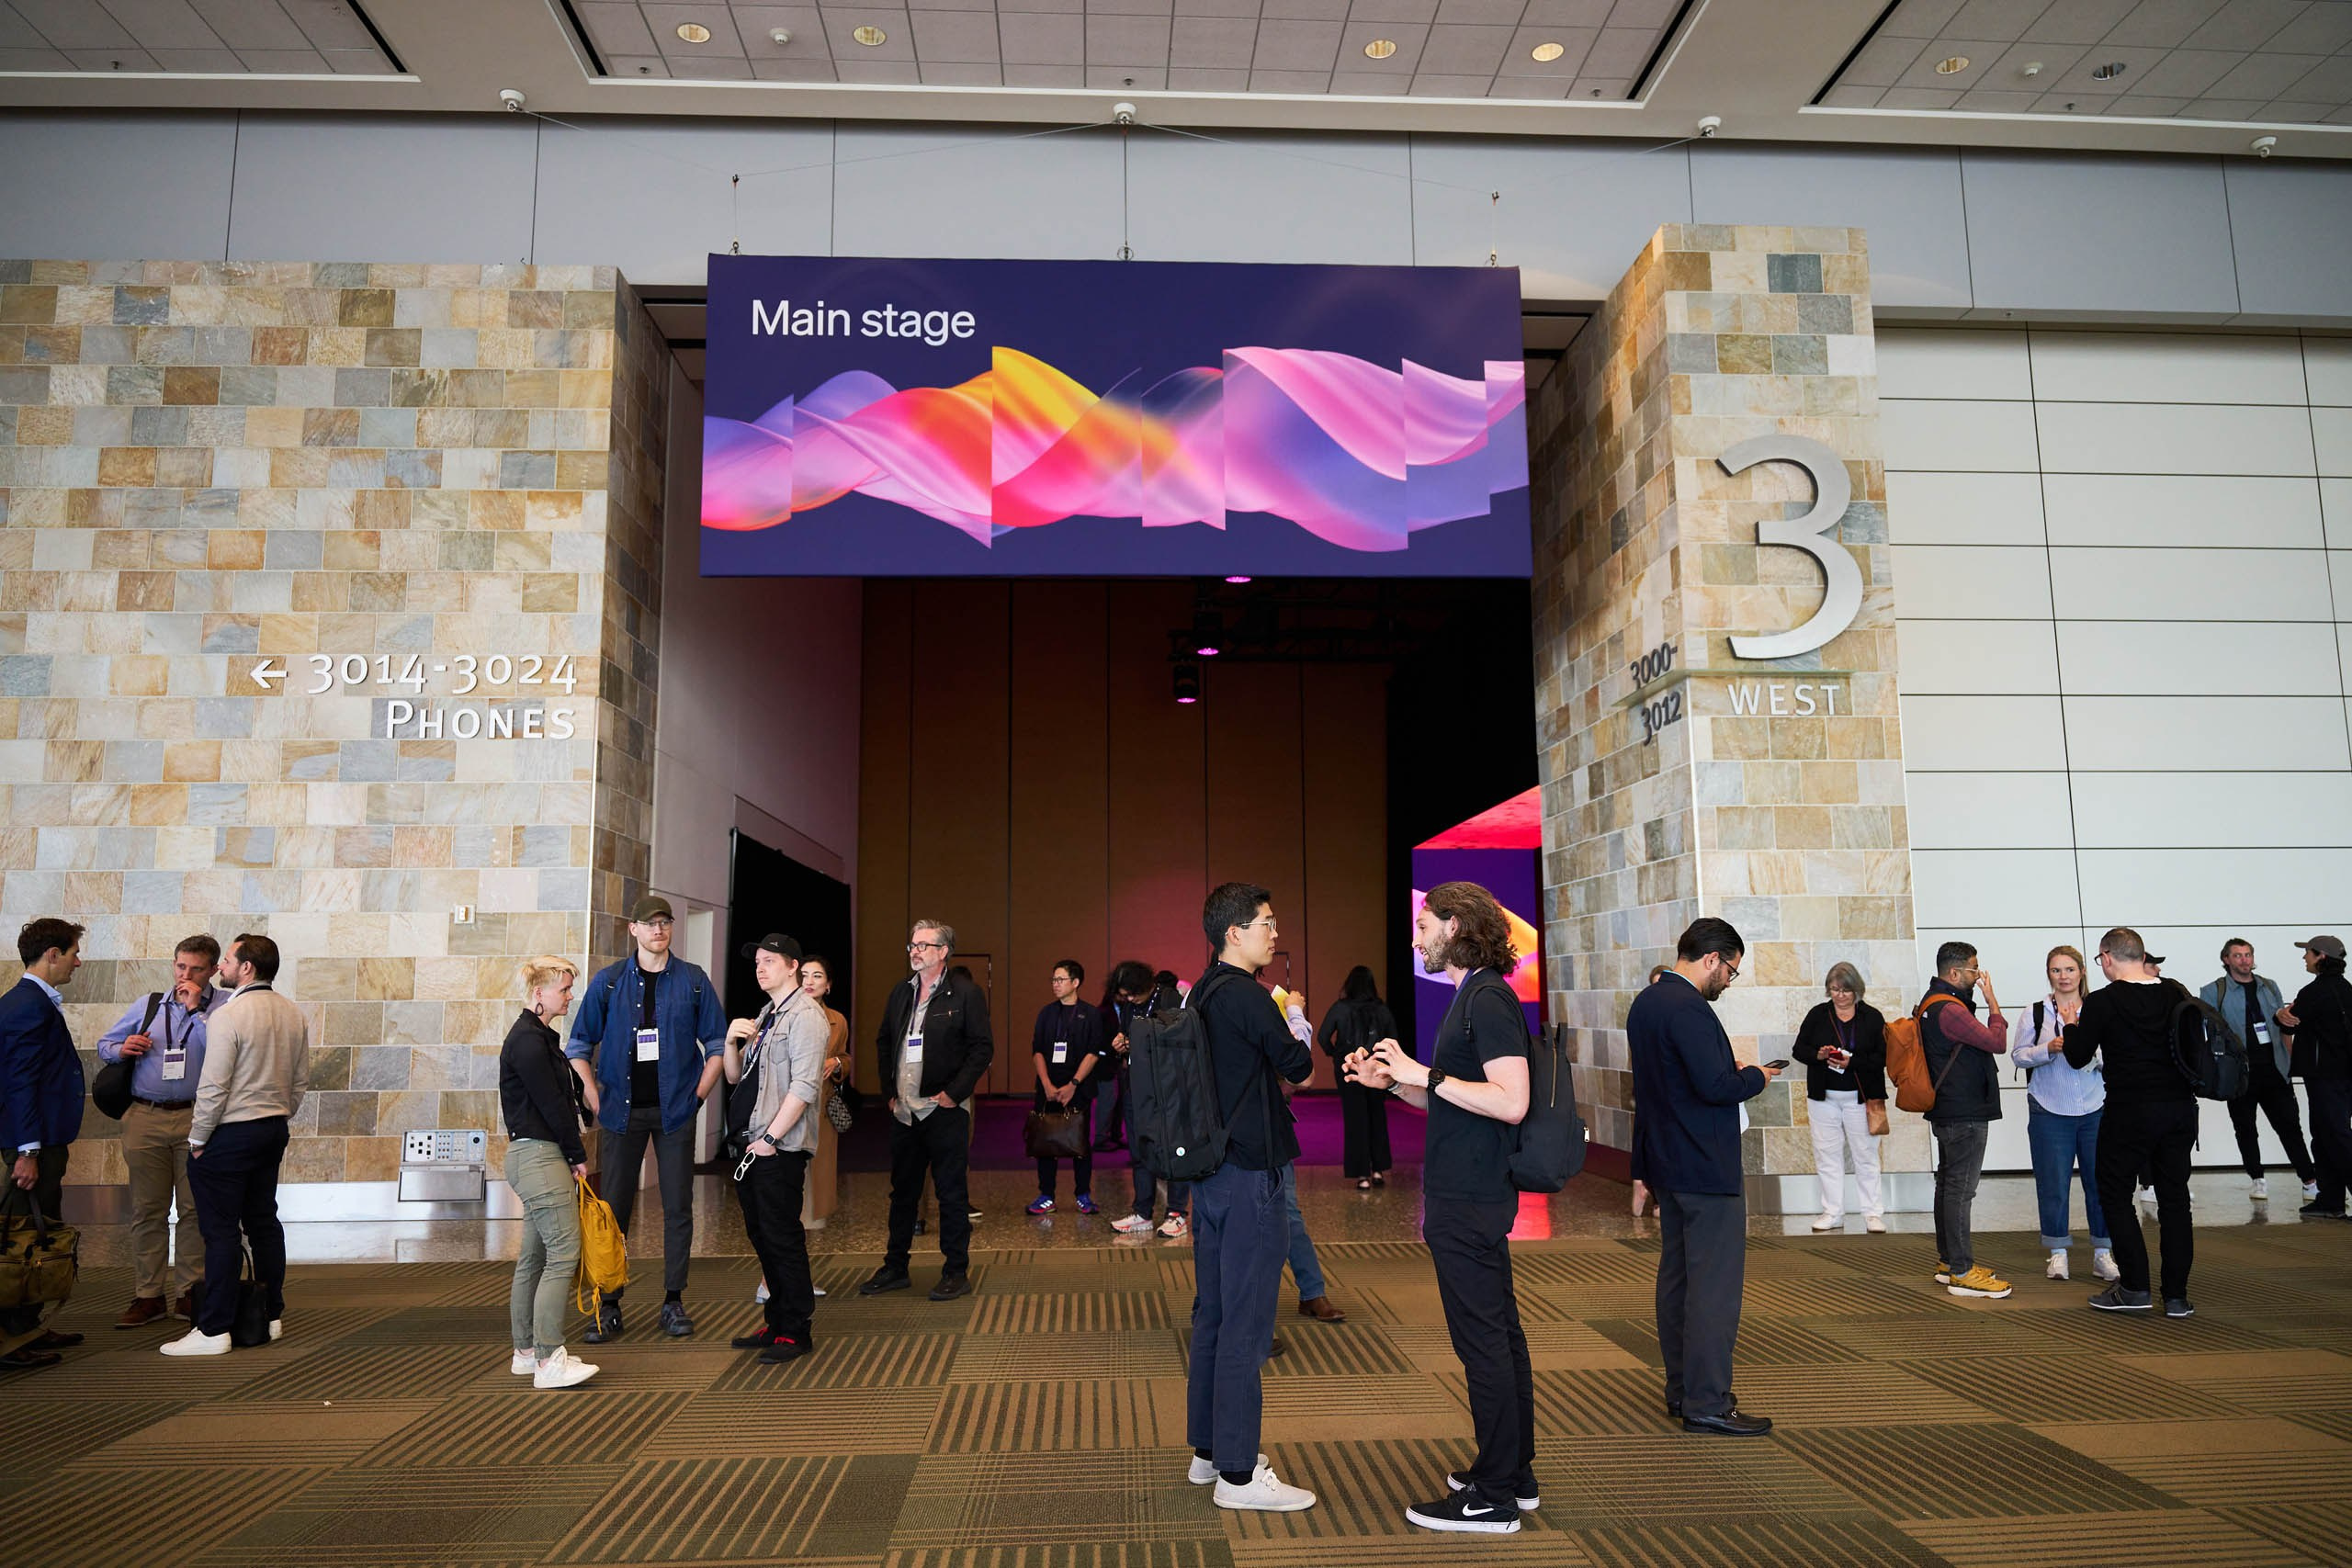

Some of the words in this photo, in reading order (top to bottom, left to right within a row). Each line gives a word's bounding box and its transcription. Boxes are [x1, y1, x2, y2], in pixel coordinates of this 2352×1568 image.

[752, 299, 851, 336] Main
[860, 303, 976, 346] stage
[1715, 434, 1864, 660] 3
[308, 653, 578, 695] 3014-3024
[1630, 641, 1679, 690] 3000-
[386, 700, 575, 740] PHONES
[1641, 691, 1682, 747] 3012
[1727, 683, 1840, 716] WEST
